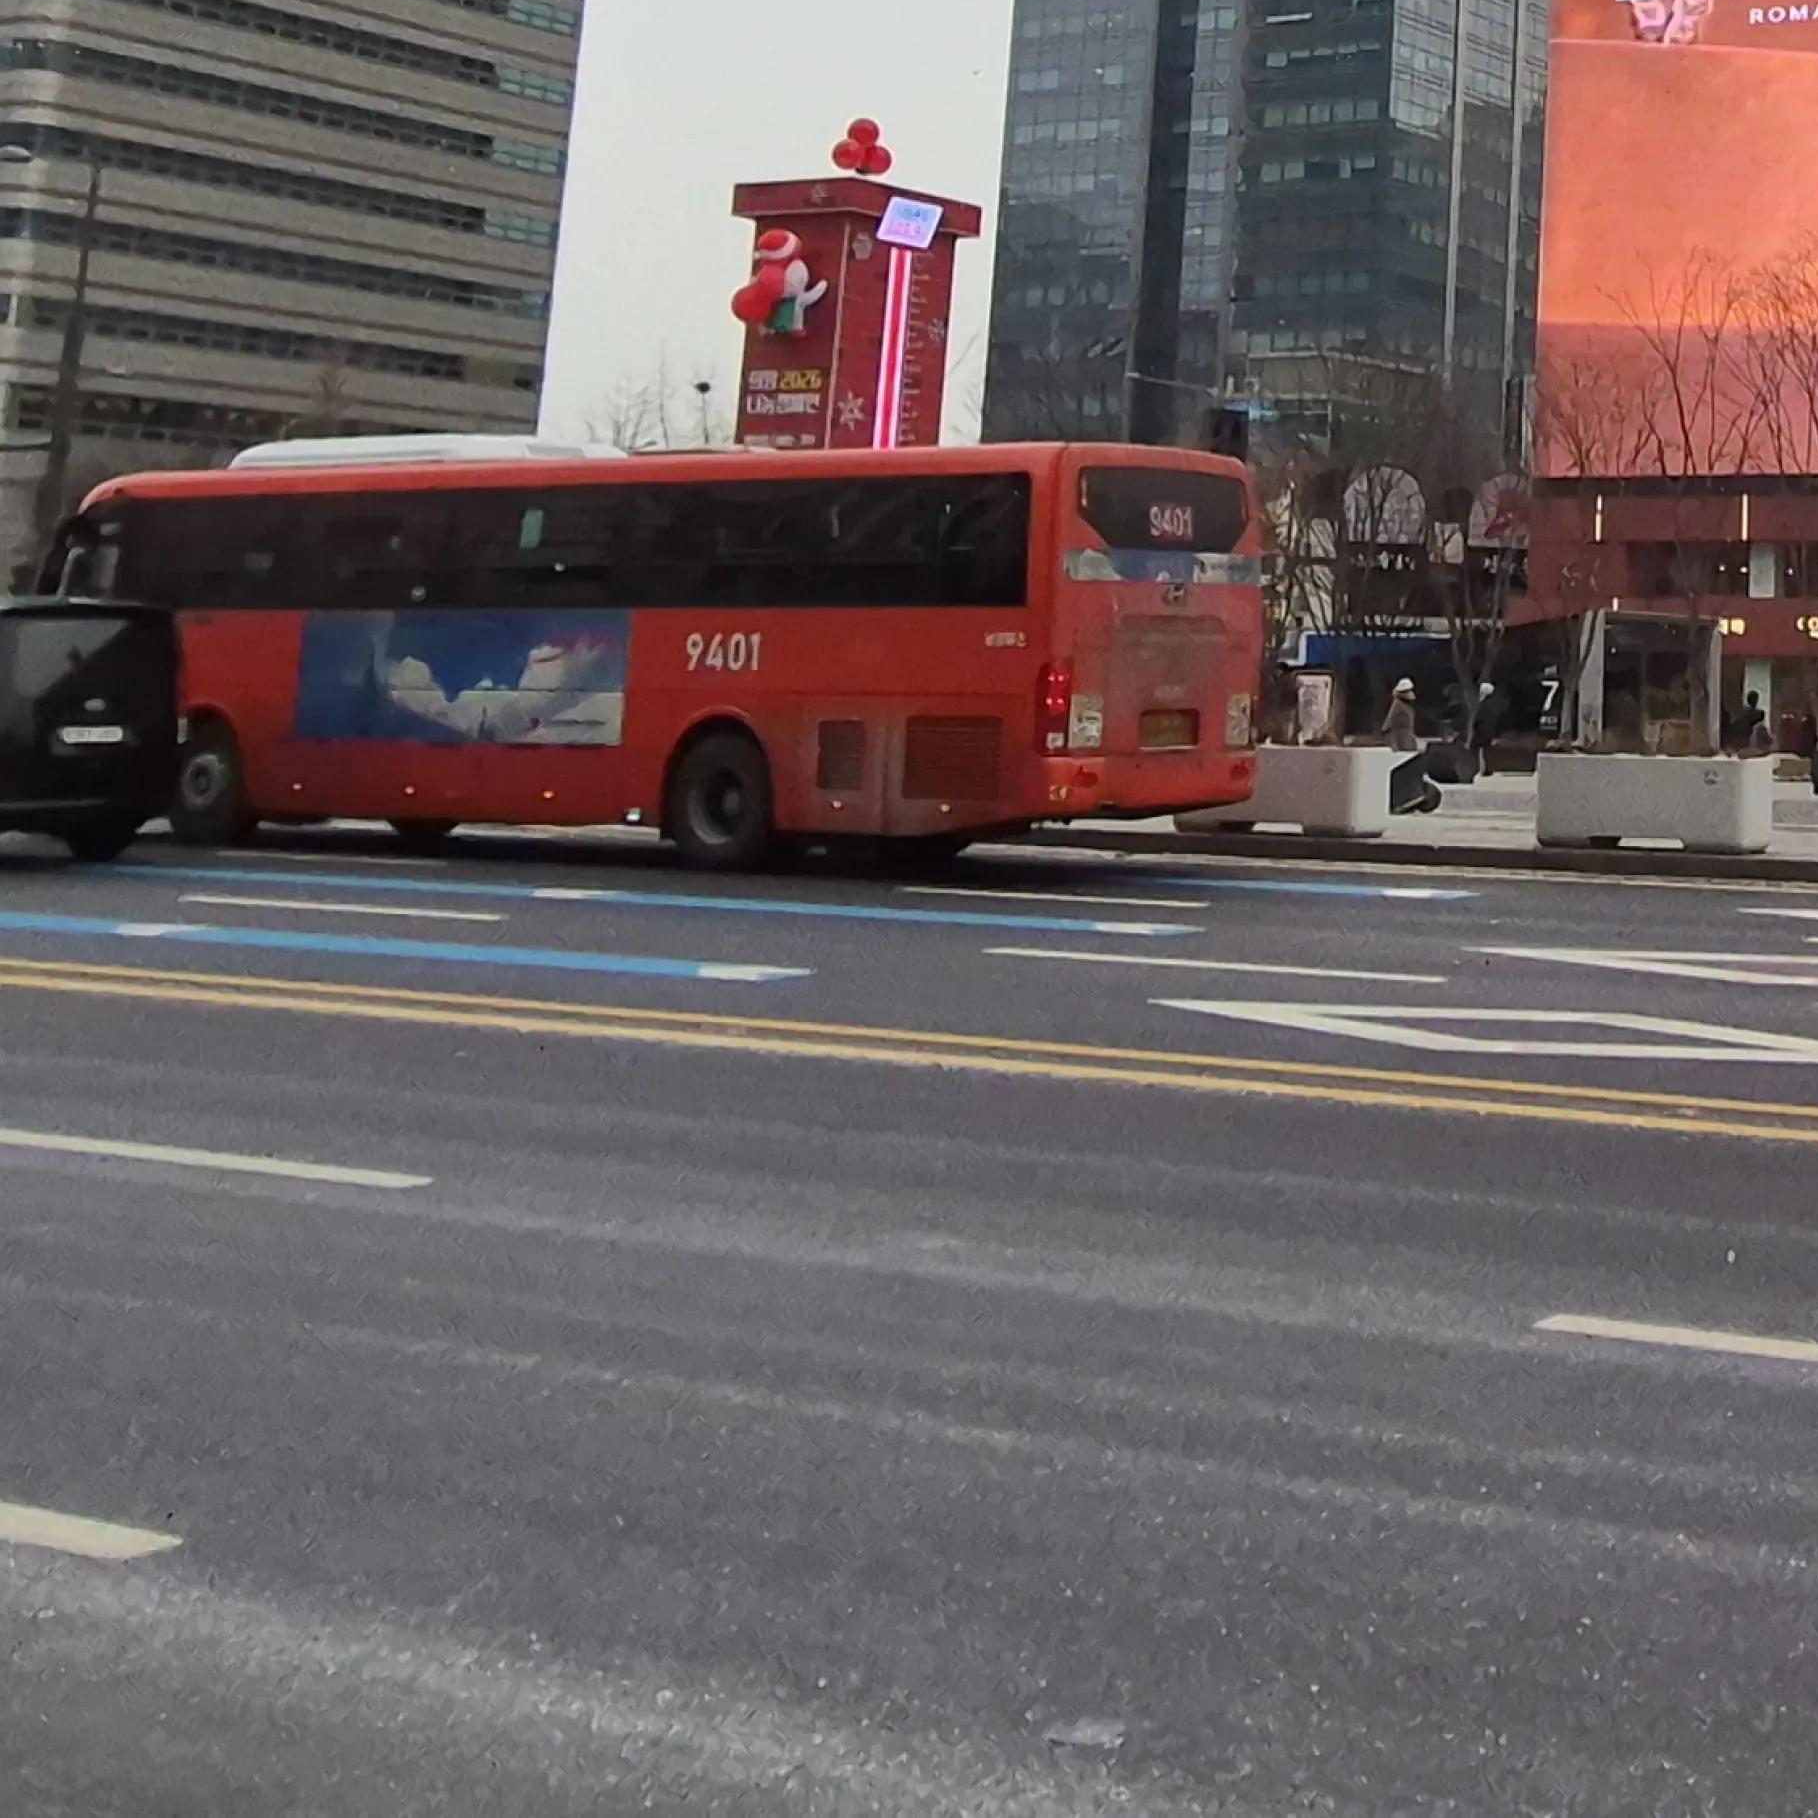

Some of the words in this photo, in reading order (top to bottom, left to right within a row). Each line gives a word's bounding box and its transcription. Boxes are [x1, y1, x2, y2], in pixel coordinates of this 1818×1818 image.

[1149, 505, 1193, 539] 9401
[685, 631, 763, 671] 9401
[1541, 680, 1560, 711] 7
